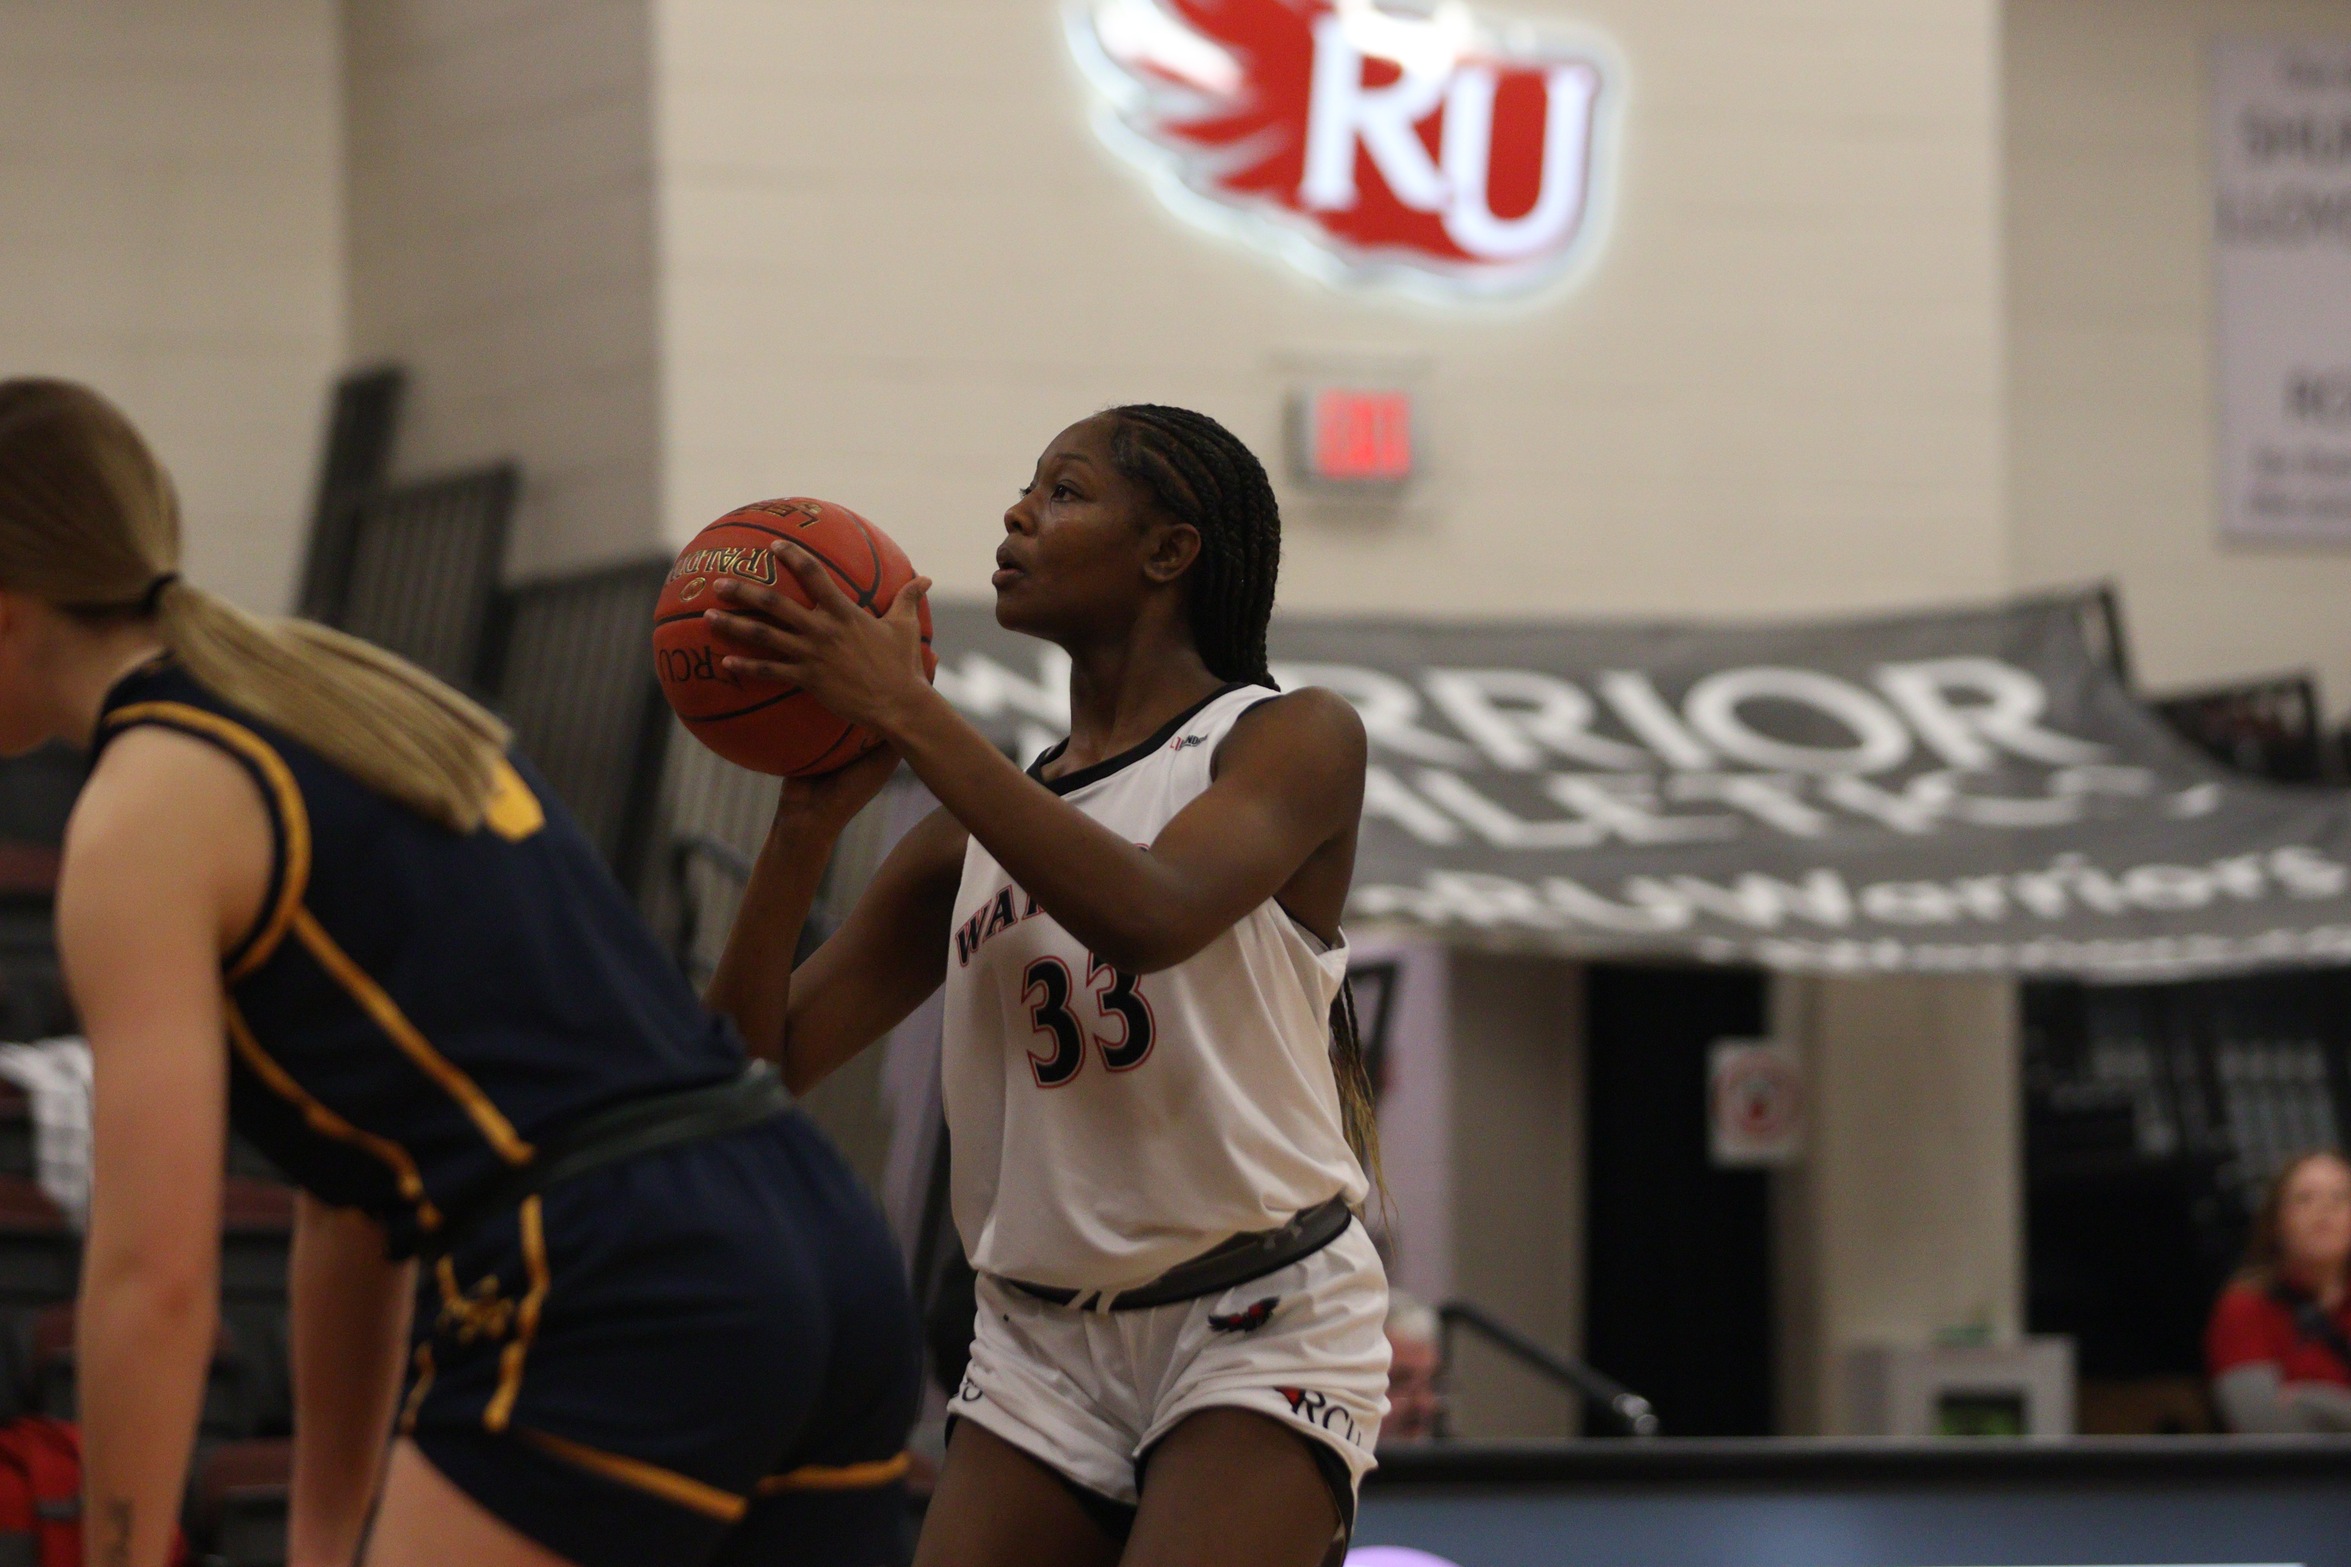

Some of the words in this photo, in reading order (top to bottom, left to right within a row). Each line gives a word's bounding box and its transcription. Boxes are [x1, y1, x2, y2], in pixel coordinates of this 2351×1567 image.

[1298, 14, 1600, 256] RU
[659, 645, 717, 682] RCU
[930, 652, 2112, 772] WRRIOR
[1021, 955, 1157, 1090] 33
